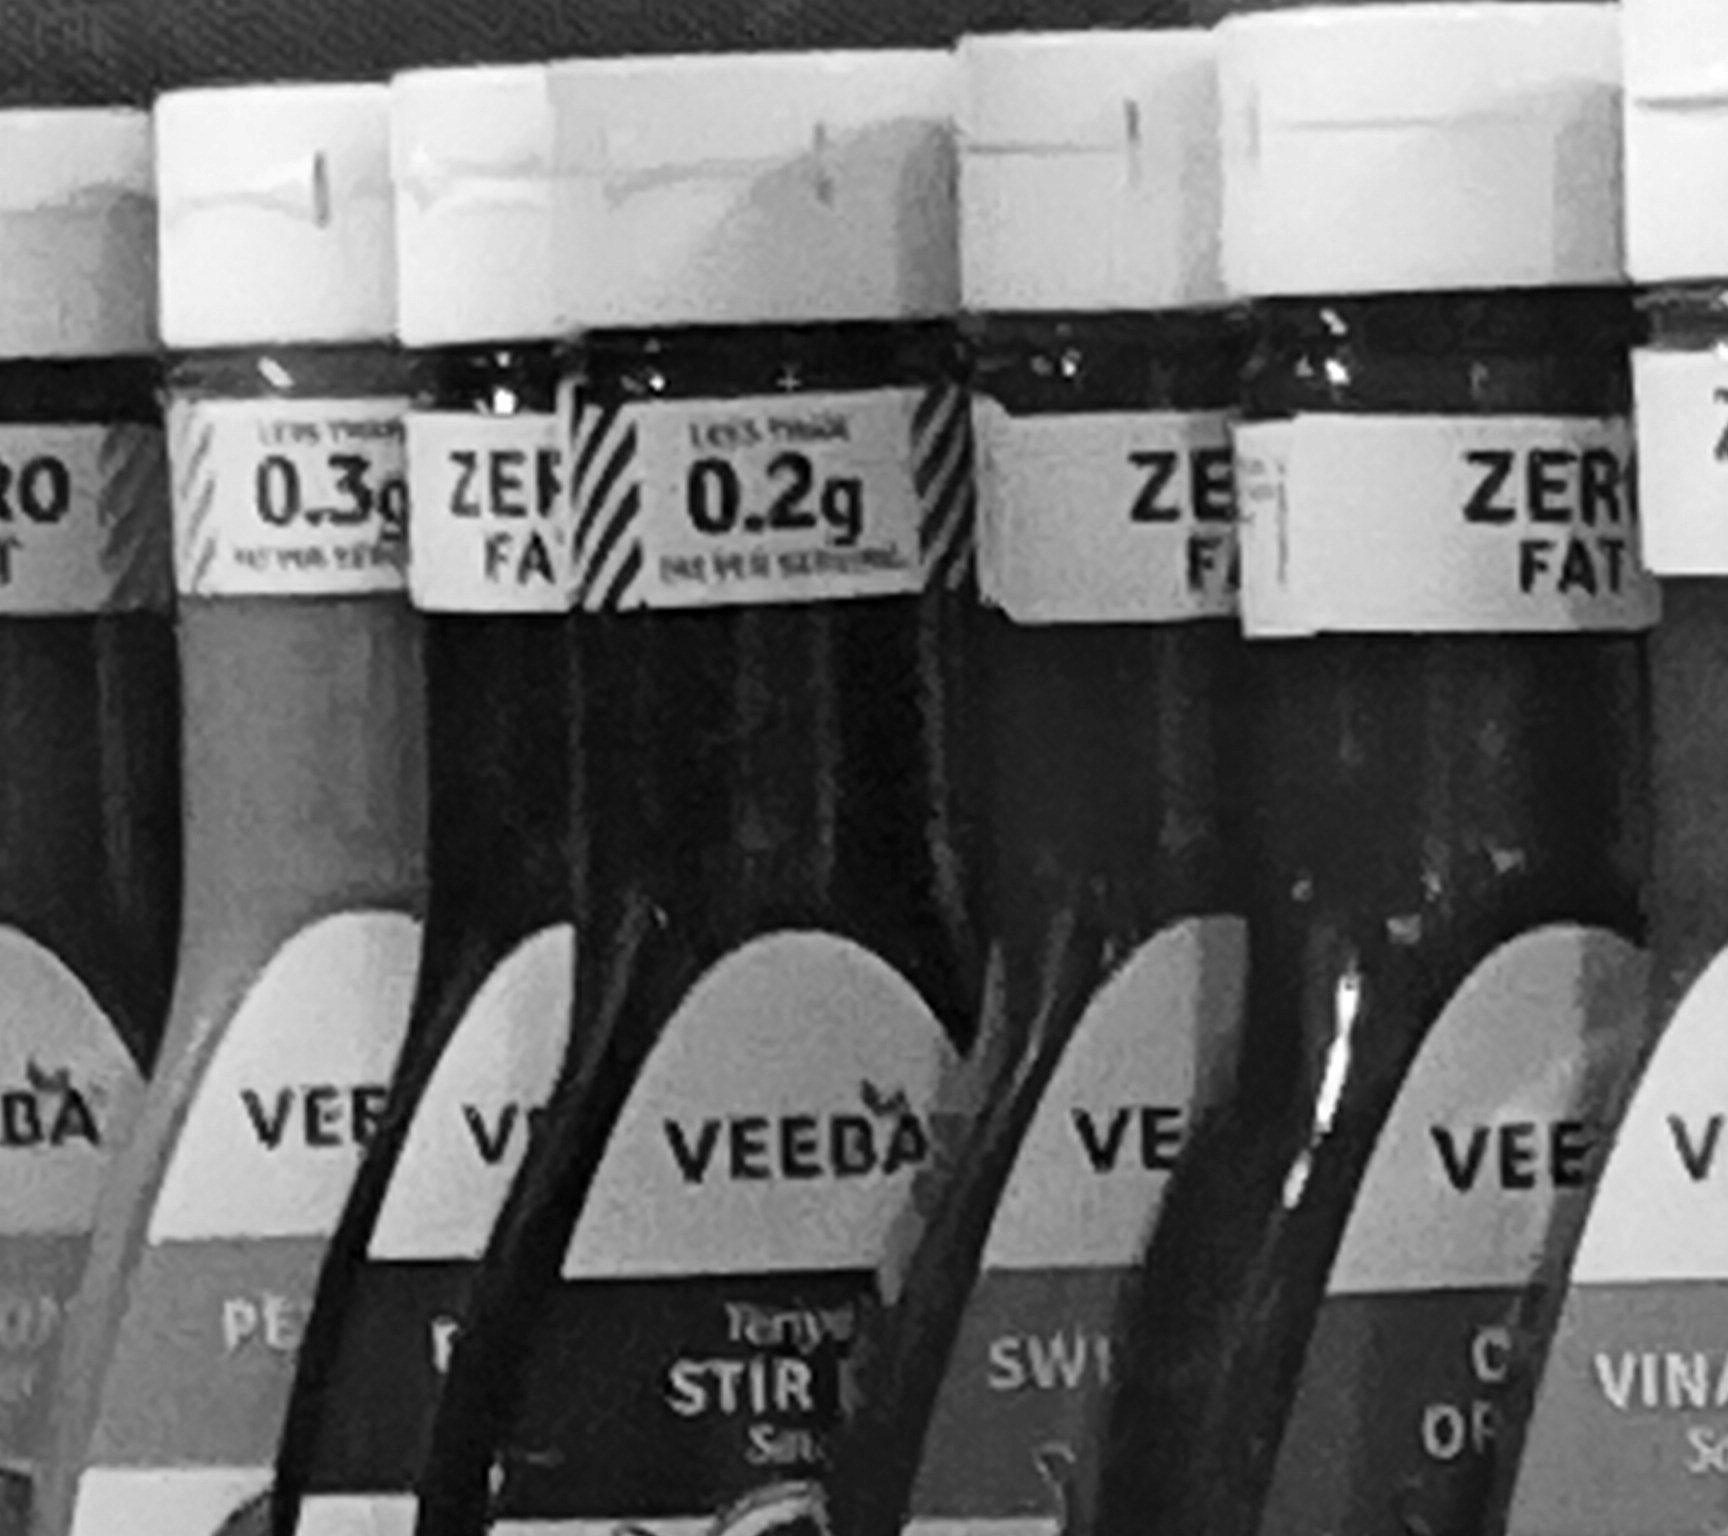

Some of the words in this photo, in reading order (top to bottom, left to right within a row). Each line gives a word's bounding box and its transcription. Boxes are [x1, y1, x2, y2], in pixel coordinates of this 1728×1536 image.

[0, 455, 71, 525] O
[256, 454, 410, 541] 0.3g
[687, 450, 863, 547] 0.2g
[1463, 448, 1638, 527] ZER
[484, 530, 566, 586] FA
[1187, 538, 1239, 592] F
[1518, 536, 1627, 596] FAT
[664, 1353, 815, 1417] STIR
